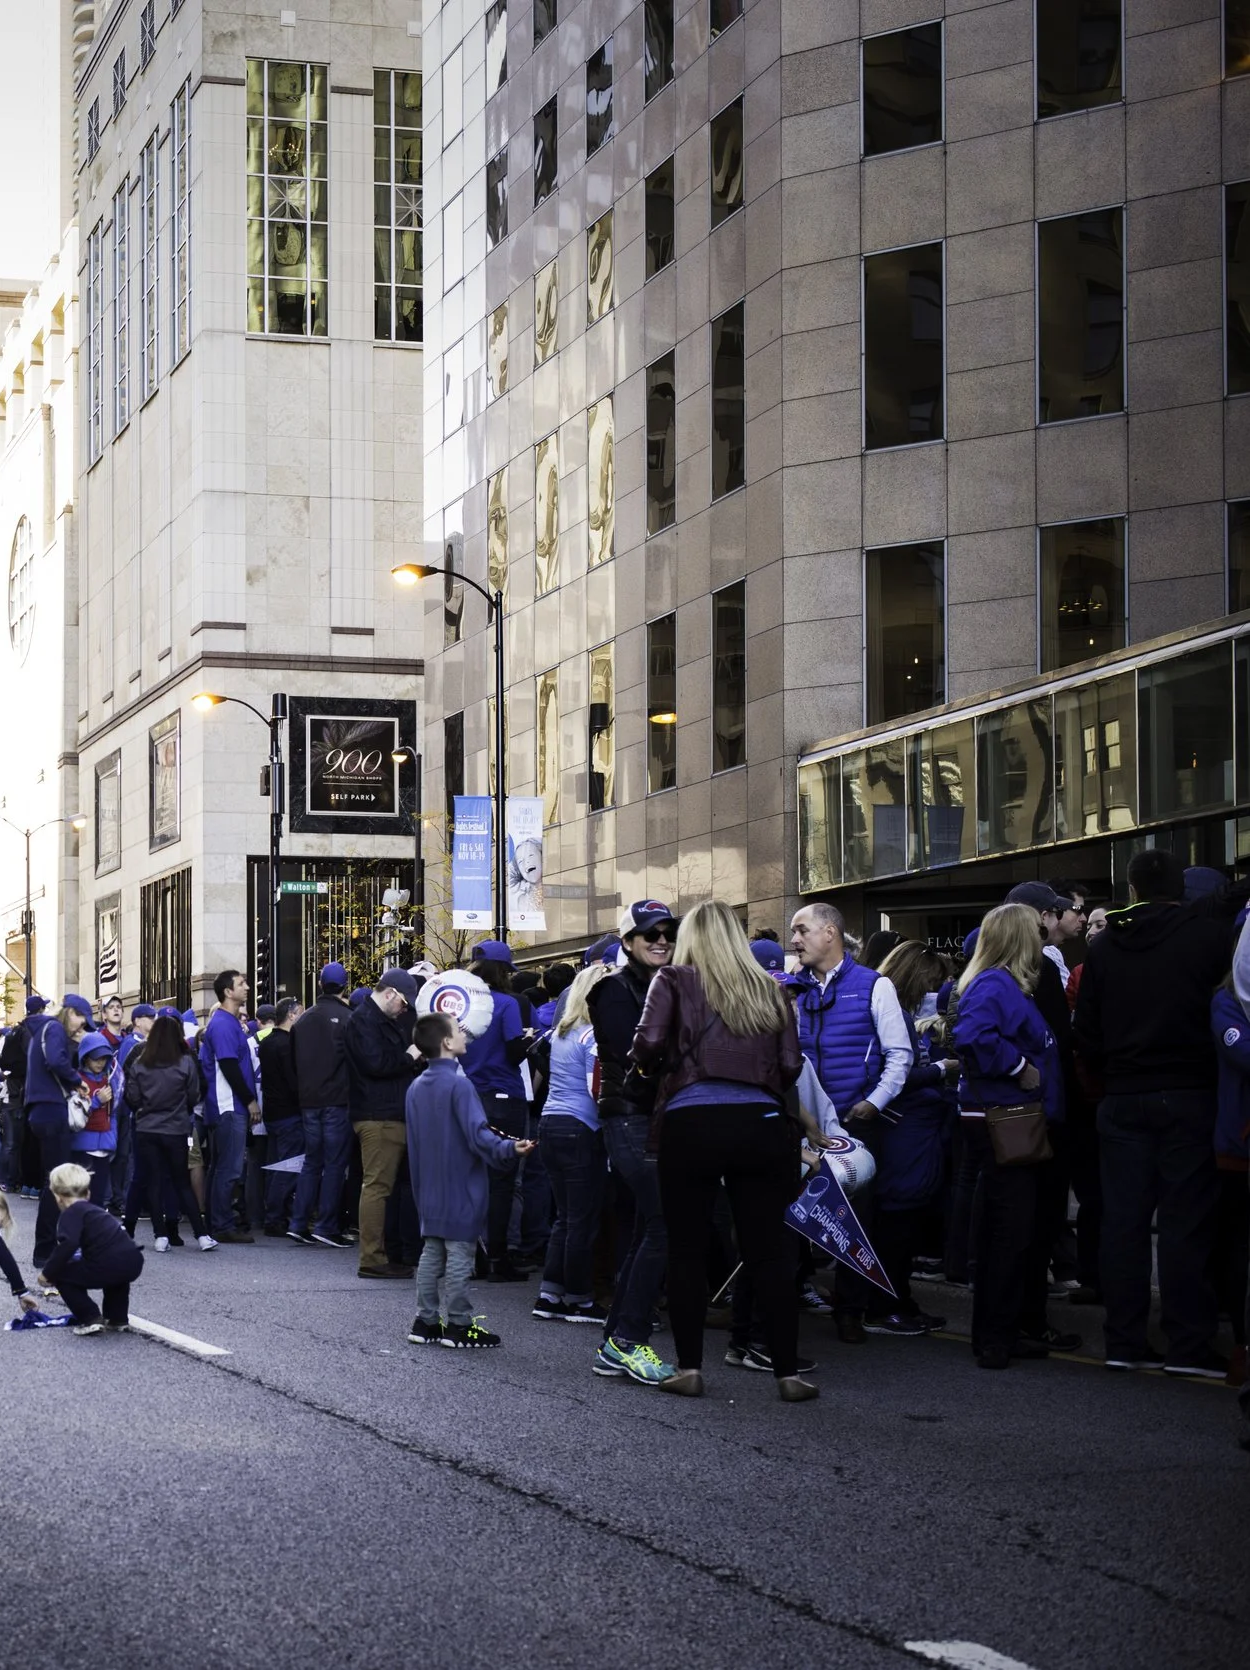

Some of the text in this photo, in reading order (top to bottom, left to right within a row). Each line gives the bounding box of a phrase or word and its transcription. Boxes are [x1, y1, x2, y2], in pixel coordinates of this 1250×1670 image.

[323, 748, 382, 775] 900
[458, 851, 469, 860] NOV
[459, 843, 467, 852] FRI
[474, 843, 484, 852] SAT
[287, 883, 311, 891] Walton
[810, 1204, 850, 1254] CHAMPIONS
[856, 1248, 874, 1271] CUBS
